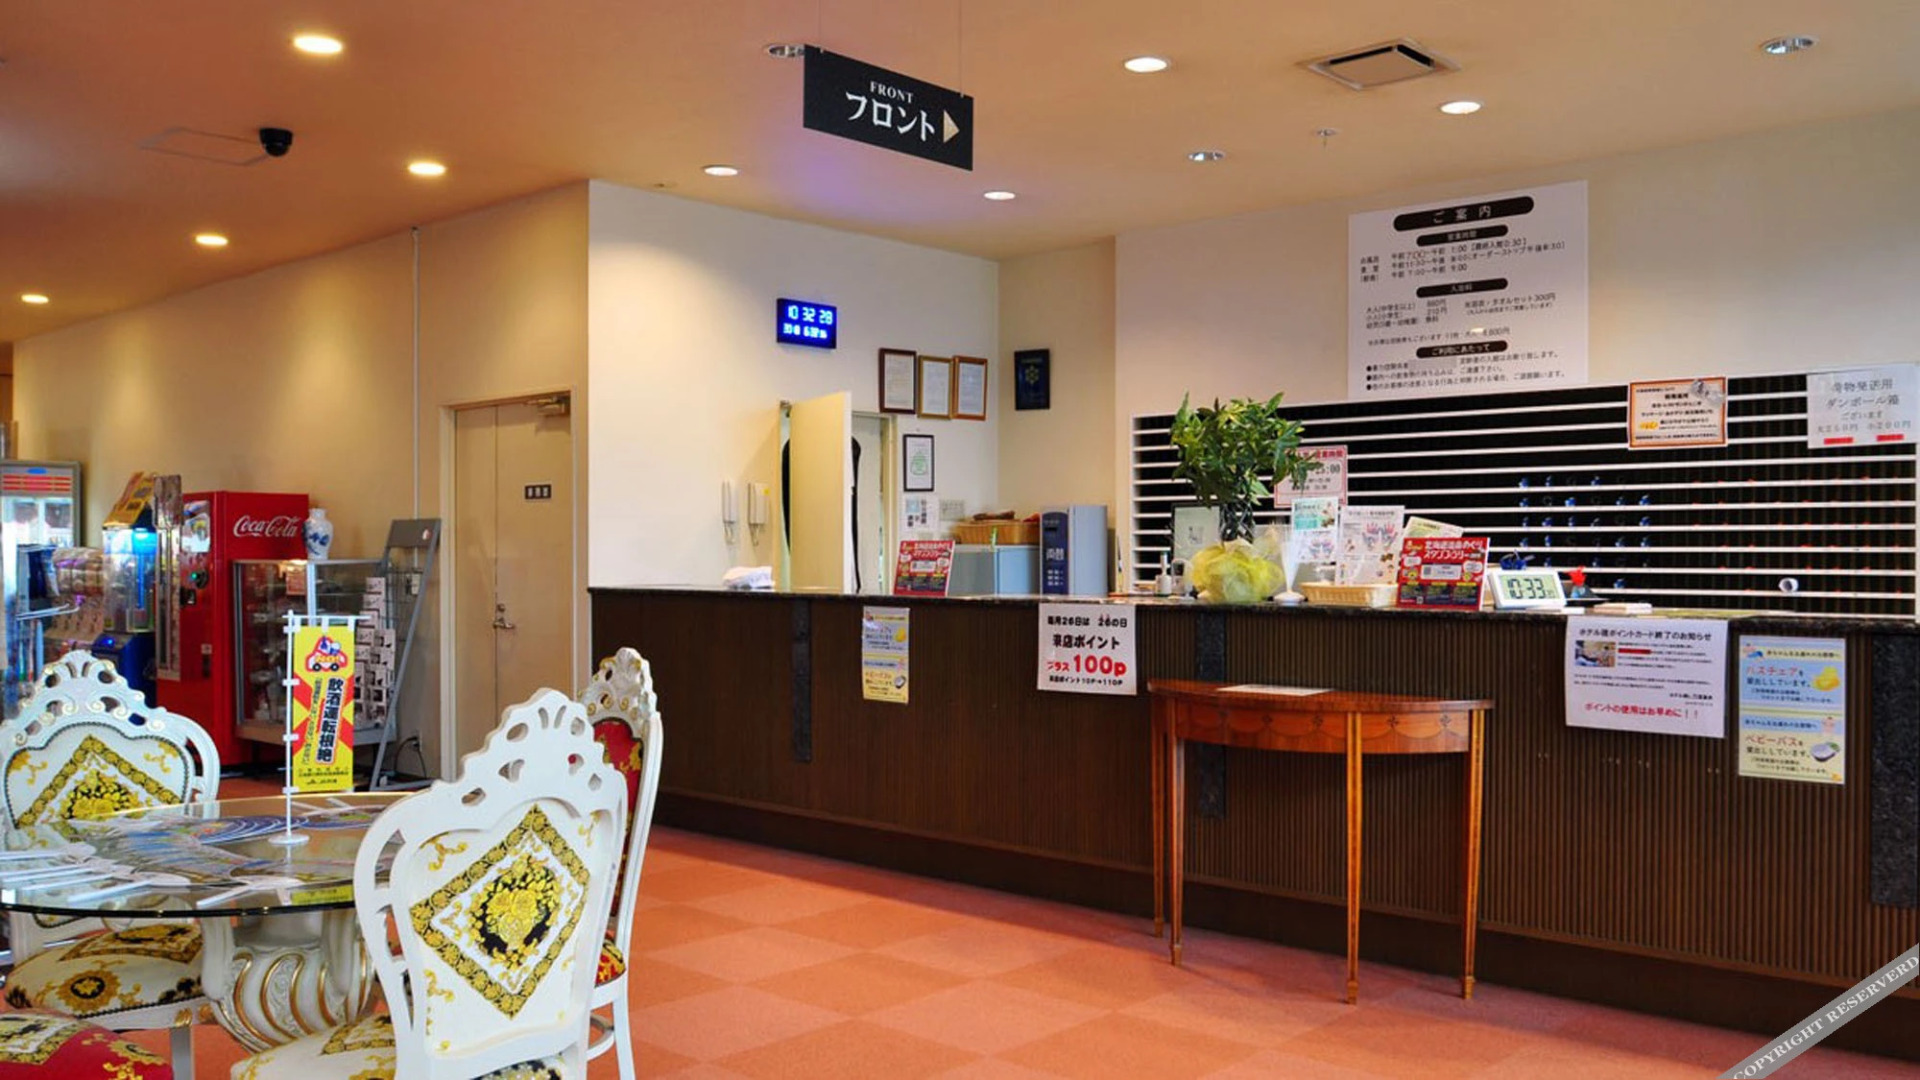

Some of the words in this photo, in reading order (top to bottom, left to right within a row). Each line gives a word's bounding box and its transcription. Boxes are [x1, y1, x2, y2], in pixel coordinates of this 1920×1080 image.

[870, 81, 914, 104] FRONT
[845, 91, 935, 142] フロント
[1052, 634, 1120, 650] 来店ポイント
[316, 677, 345, 763] 飲酒運転根絶
